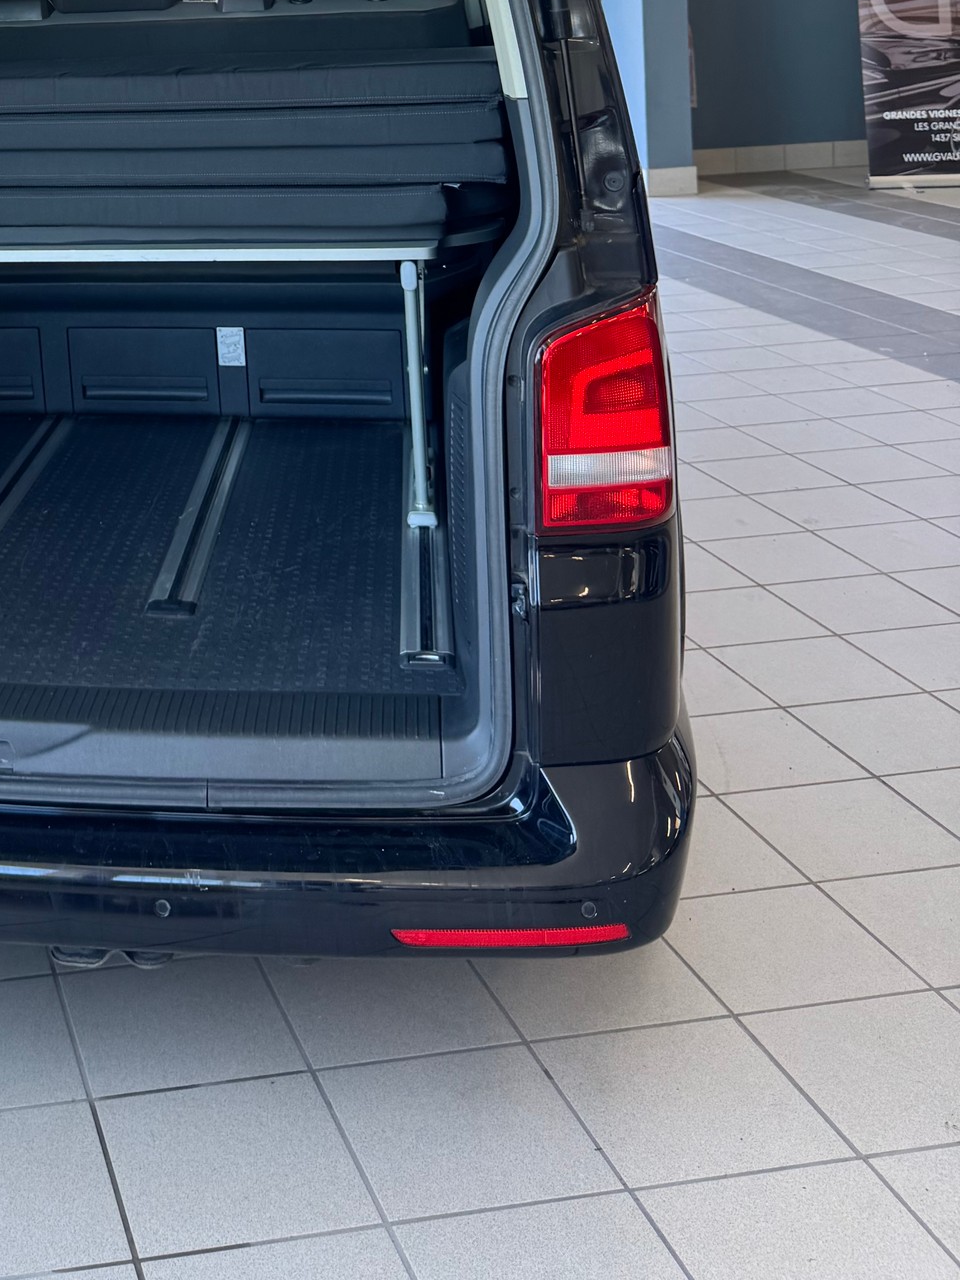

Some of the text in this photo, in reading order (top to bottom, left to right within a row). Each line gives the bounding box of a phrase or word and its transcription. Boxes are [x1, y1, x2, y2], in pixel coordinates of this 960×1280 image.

[882, 110, 928, 120] GRANDES
[914, 122, 929, 131] LES
[931, 133, 951, 142] 1437
